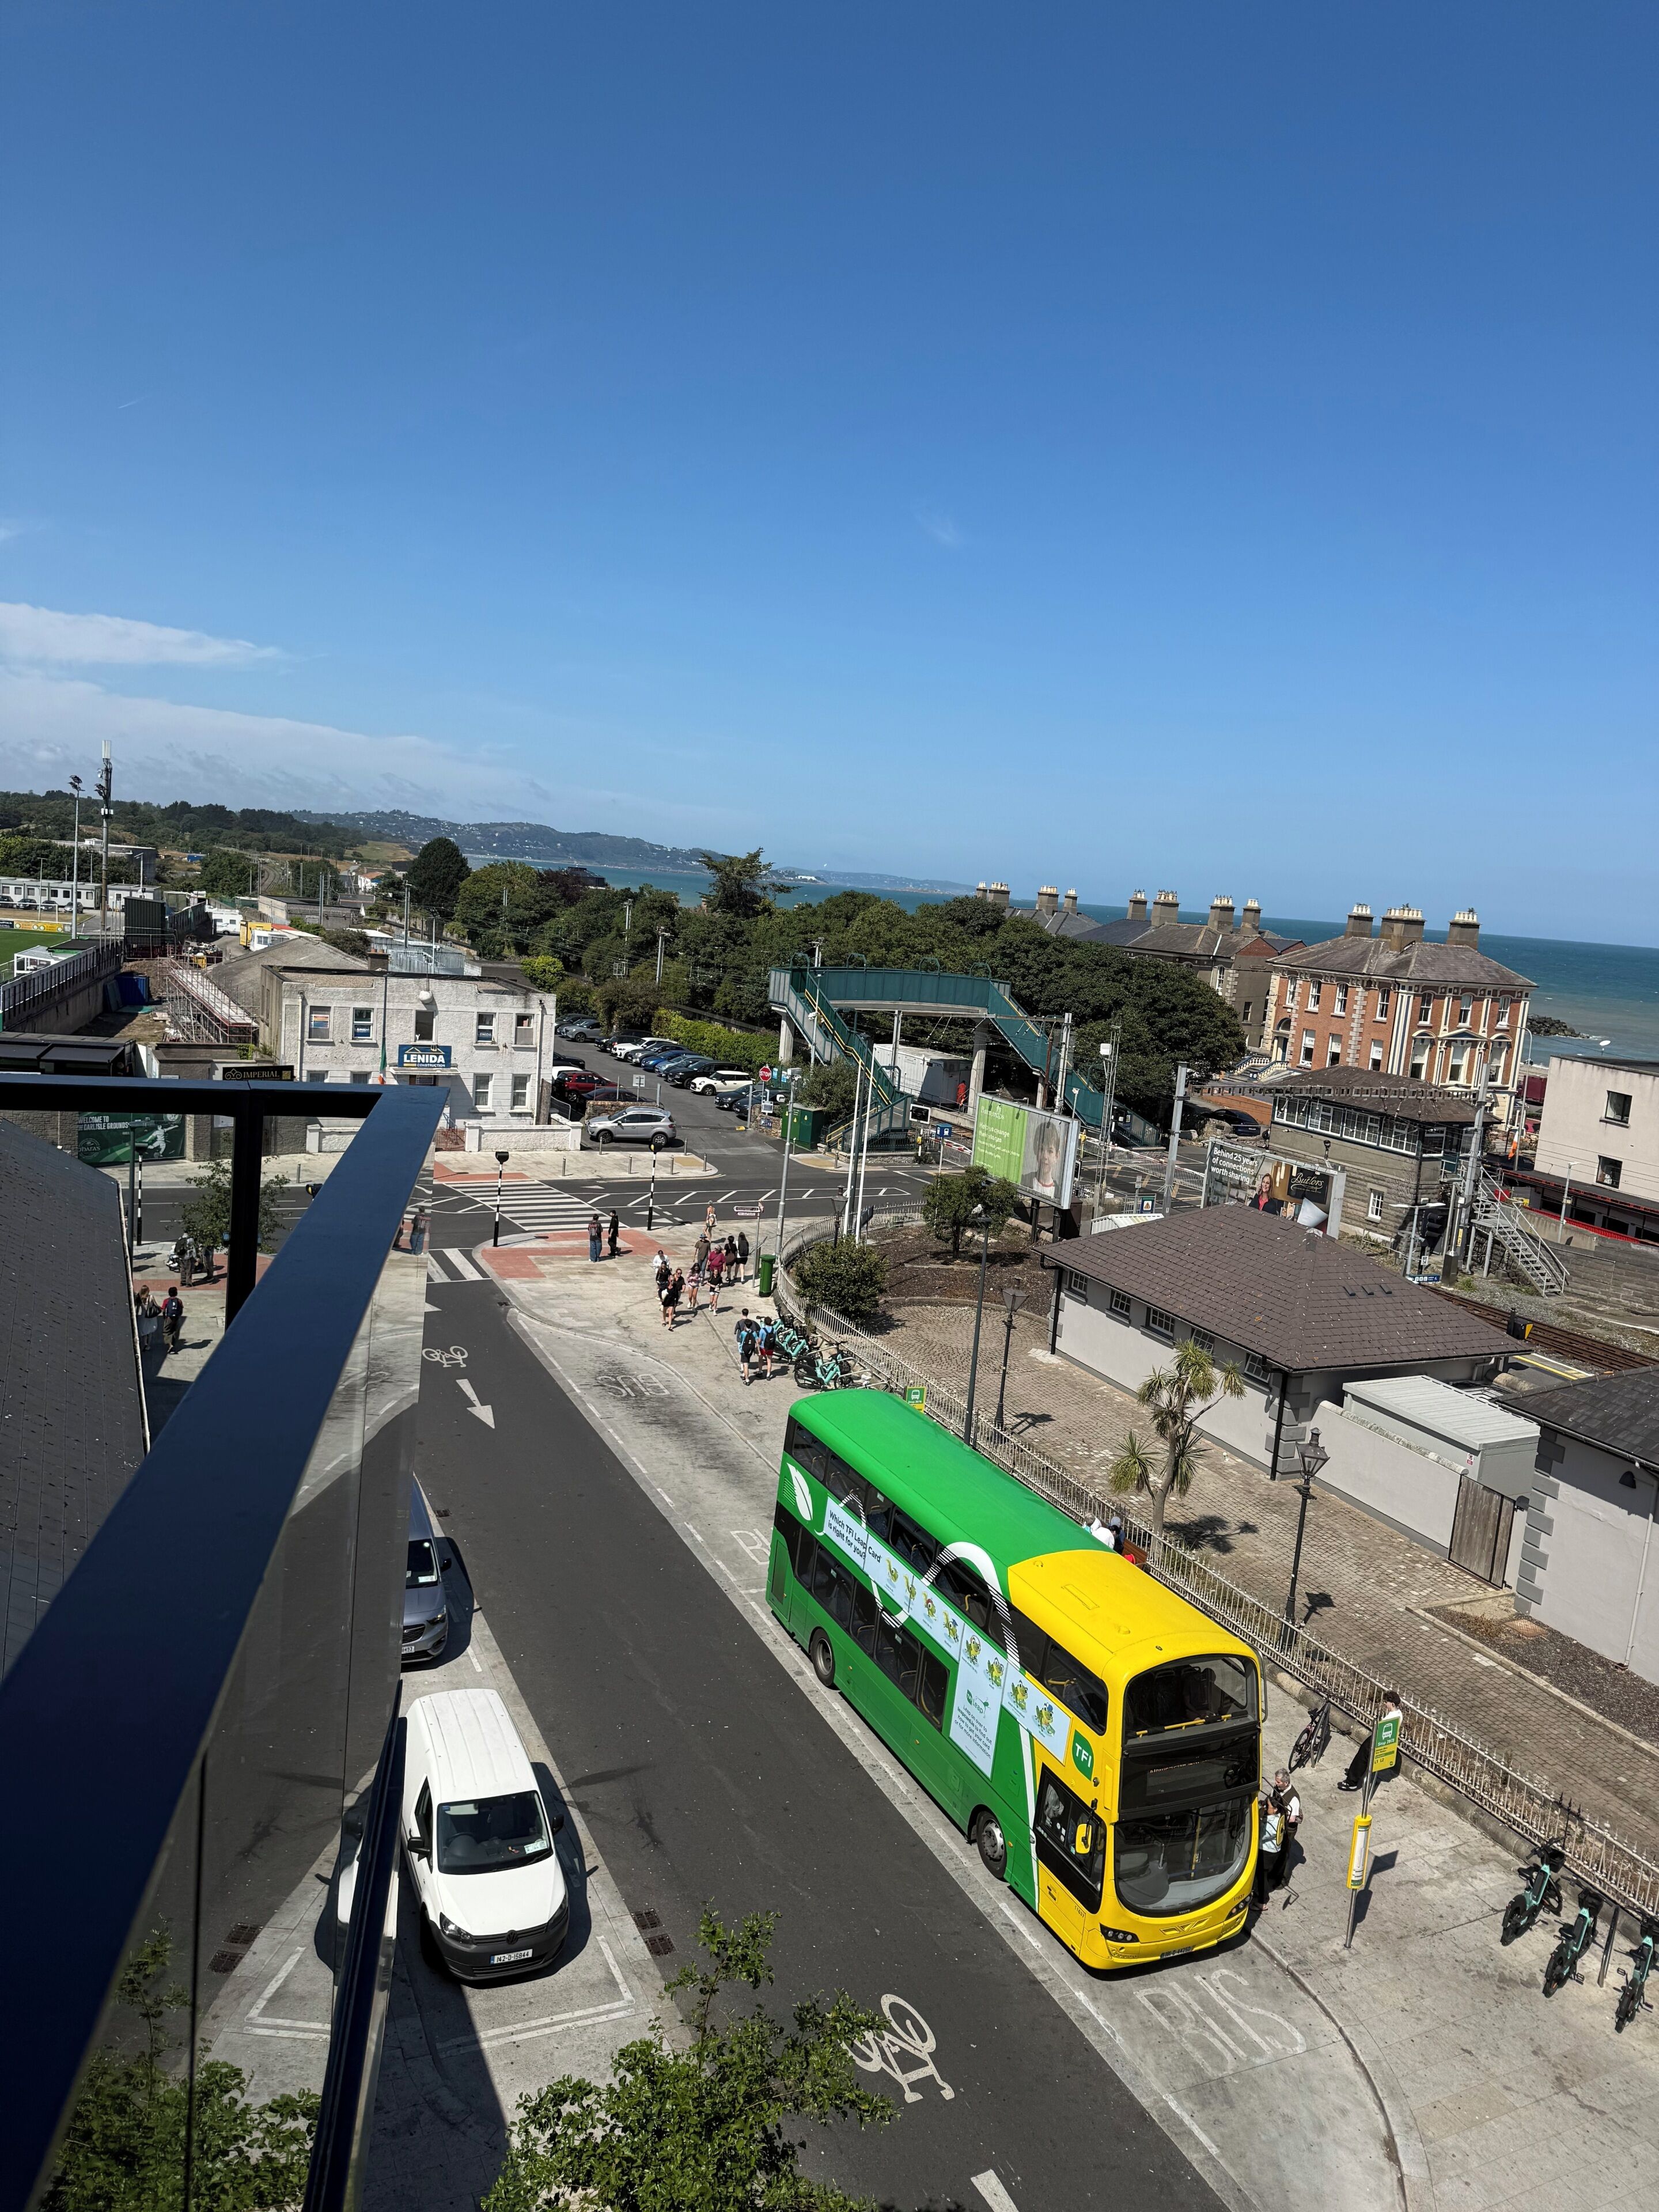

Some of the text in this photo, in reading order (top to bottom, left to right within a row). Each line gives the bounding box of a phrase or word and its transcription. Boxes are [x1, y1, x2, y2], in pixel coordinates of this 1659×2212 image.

[404, 1054, 445, 1063] LENIDA
[994, 1127, 1009, 1138] change
[1214, 1147, 1258, 1167] Behind 25 years
[1219, 1158, 1254, 1175] connections
[1211, 1165, 1249, 1185] worth sharing
[596, 1374, 671, 1397] BUS
[828, 1520, 865, 1560] is right for you?
[830, 1509, 881, 1563] Which TFI Leap Card
[972, 1698, 983, 1714] Leap
[963, 1729, 972, 1740] more
[1075, 1743, 1092, 1768] TFI
[497, 1950, 529, 1963] 142-D-15844
[1133, 1969, 1306, 2077] BUS
